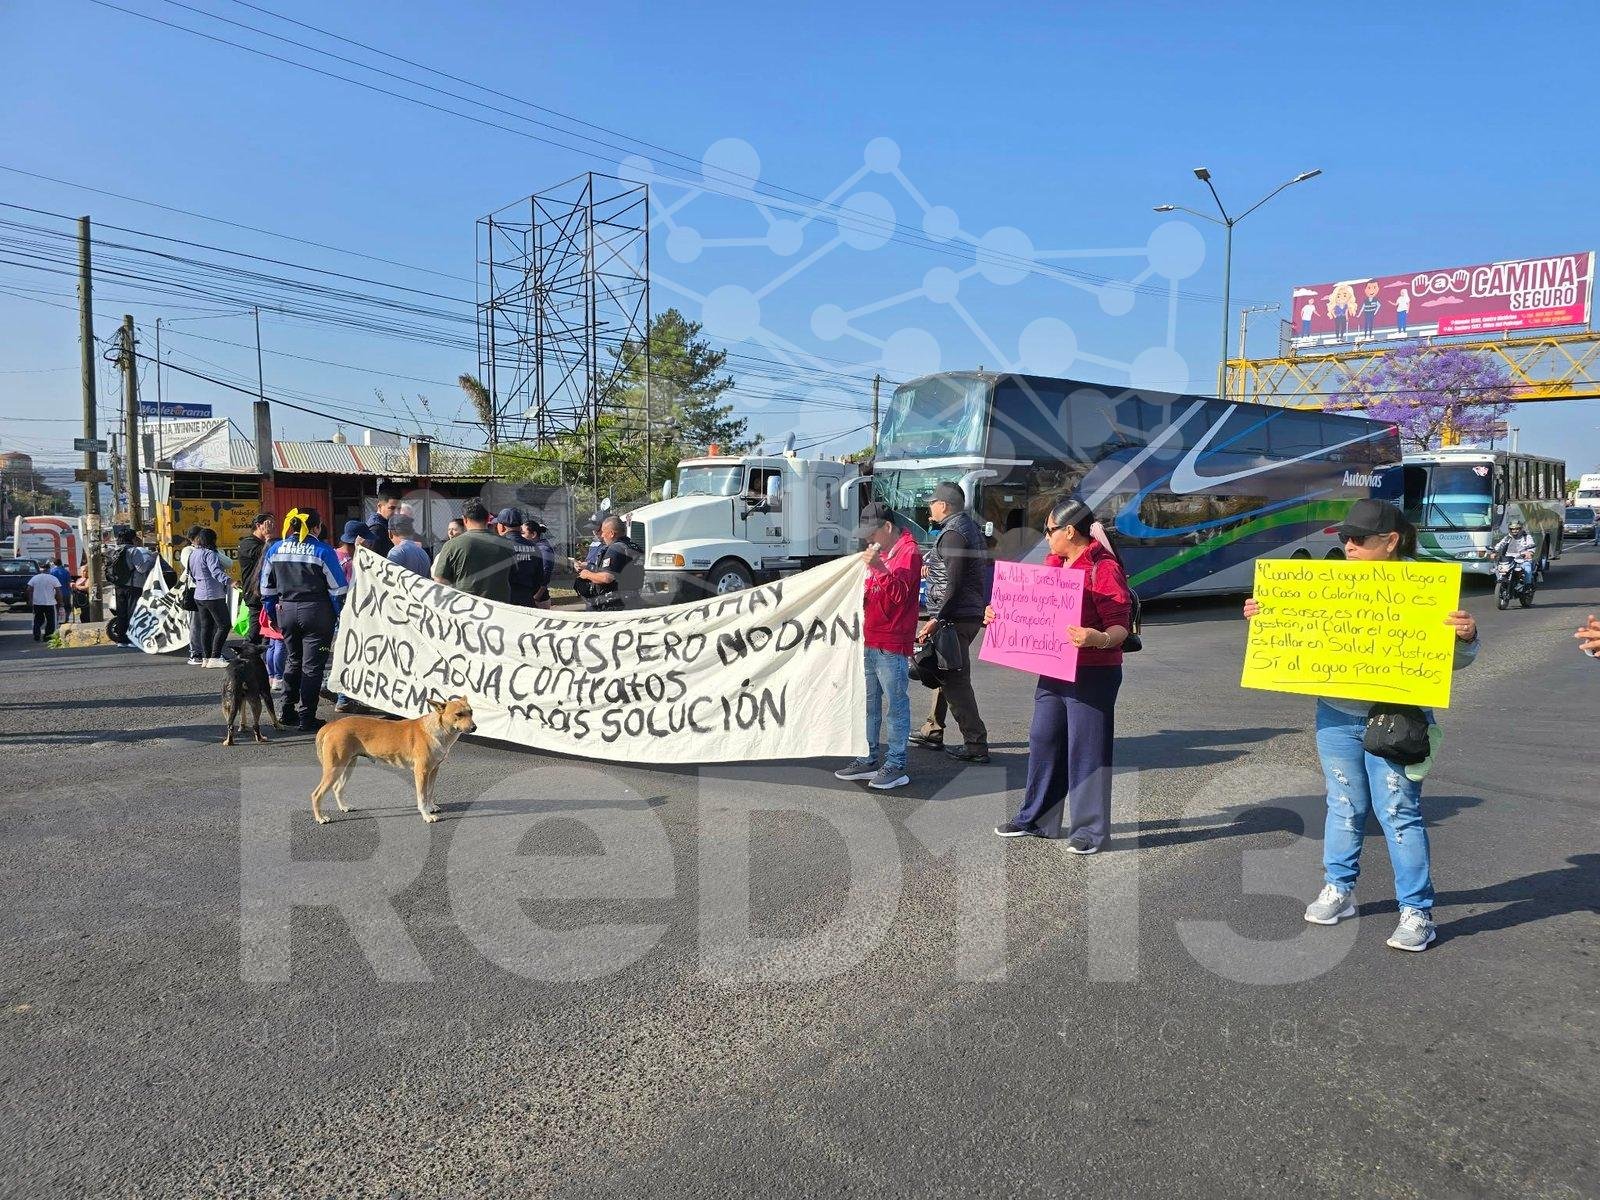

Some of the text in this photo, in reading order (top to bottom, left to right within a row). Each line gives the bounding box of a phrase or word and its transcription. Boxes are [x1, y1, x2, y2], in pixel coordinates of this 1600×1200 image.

[1474, 258, 1575, 296] CAMINA
[1512, 287, 1574, 310] SEGURO
[1341, 470, 1383, 488] Autovías
[1308, 590, 1318, 599] o
[351, 581, 390, 618] UN
[387, 594, 505, 656] SERVICIO
[612, 628, 707, 670] PERO
[986, 621, 1007, 648] NO
[1367, 625, 1381, 636] el
[1388, 628, 1427, 647] agua
[423, 651, 503, 703] AGUA
[1287, 655, 1301, 671] al
[1311, 663, 1348, 683] agua
[1393, 661, 1442, 685] todos
[339, 667, 463, 714] QUEREM
[601, 679, 789, 742] SOLUCIÓN
